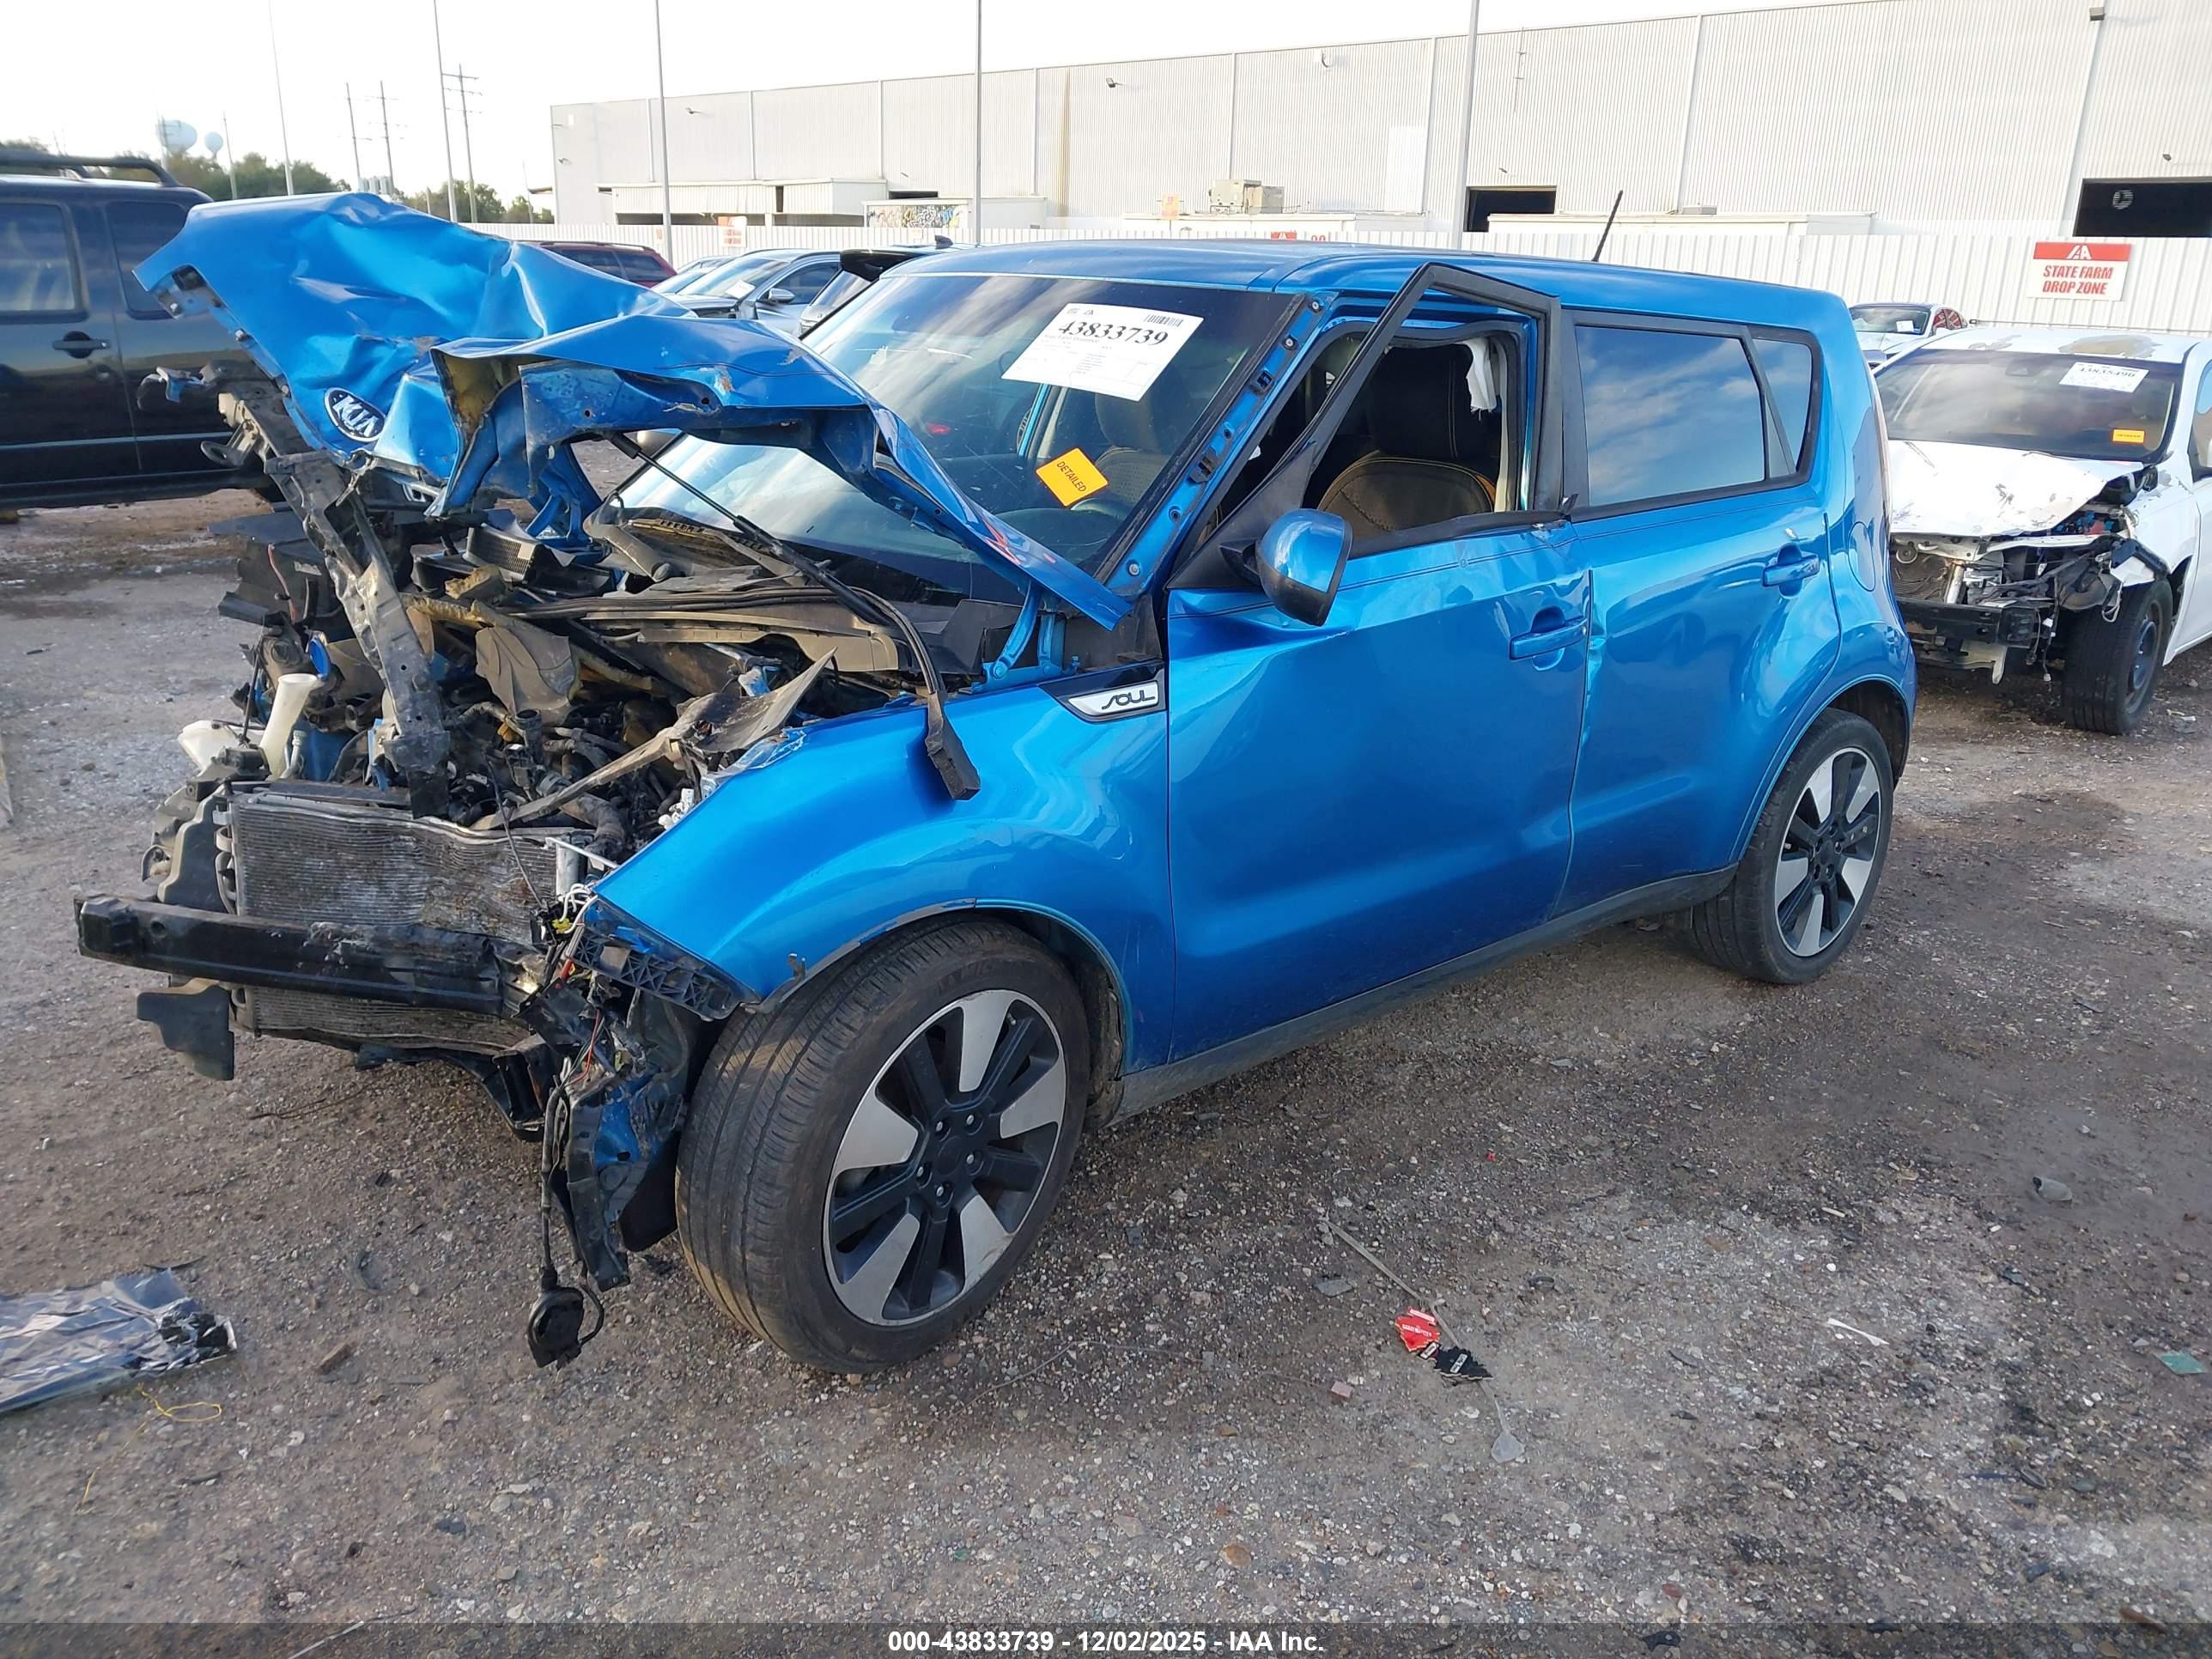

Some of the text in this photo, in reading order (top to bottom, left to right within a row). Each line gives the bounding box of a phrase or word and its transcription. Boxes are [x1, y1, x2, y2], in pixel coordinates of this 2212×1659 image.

[2043, 264, 2114, 279] STATE FARM
[2042, 280, 2108, 295] DROP ZONE
[1059, 320, 1169, 346] 43833739
[332, 395, 379, 437] KIA
[1056, 461, 1087, 492] DETAILED
[1101, 690, 1156, 710] SOUL
